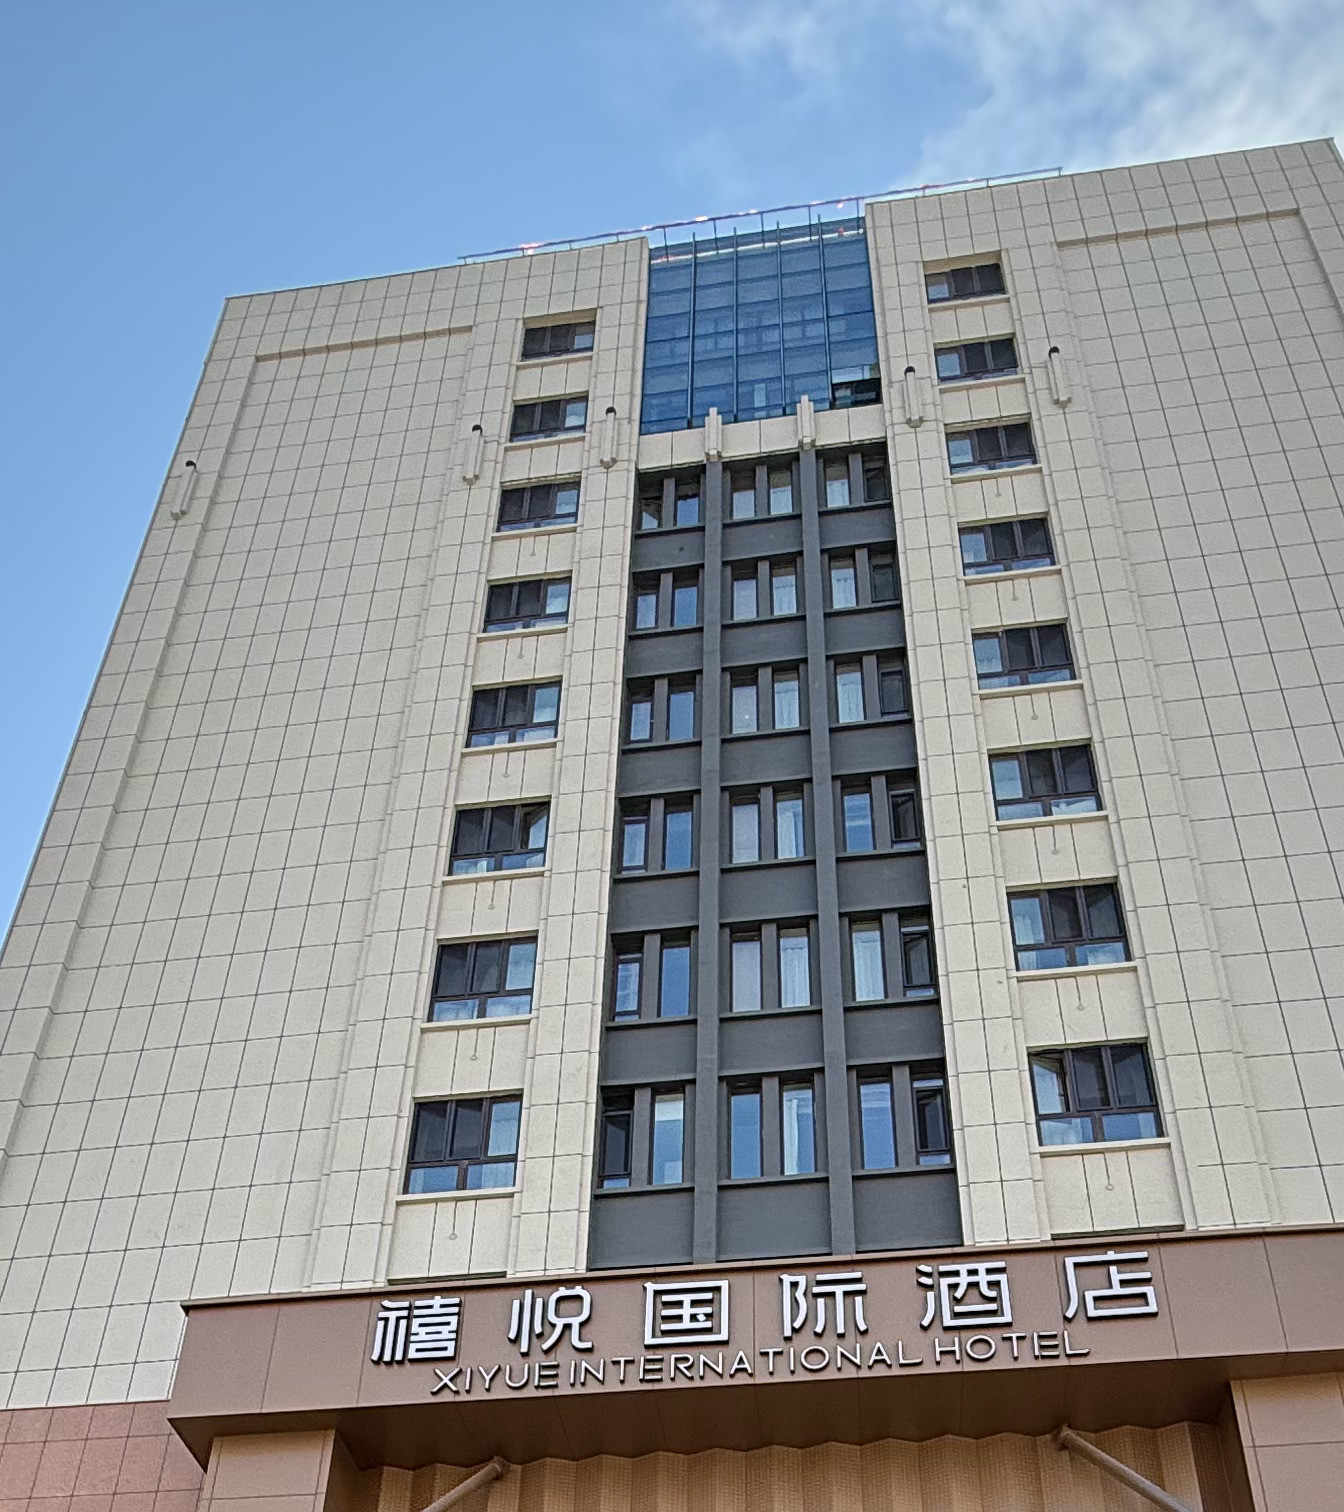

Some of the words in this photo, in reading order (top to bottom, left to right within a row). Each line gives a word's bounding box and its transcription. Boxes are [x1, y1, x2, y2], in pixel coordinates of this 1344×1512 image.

[370, 1250, 1159, 1366] 禧悦国际酒店
[430, 1362, 559, 1397] XIYUE
[567, 1338, 925, 1388] INTERNATIONAL
[933, 1329, 1090, 1363] HOTEL
